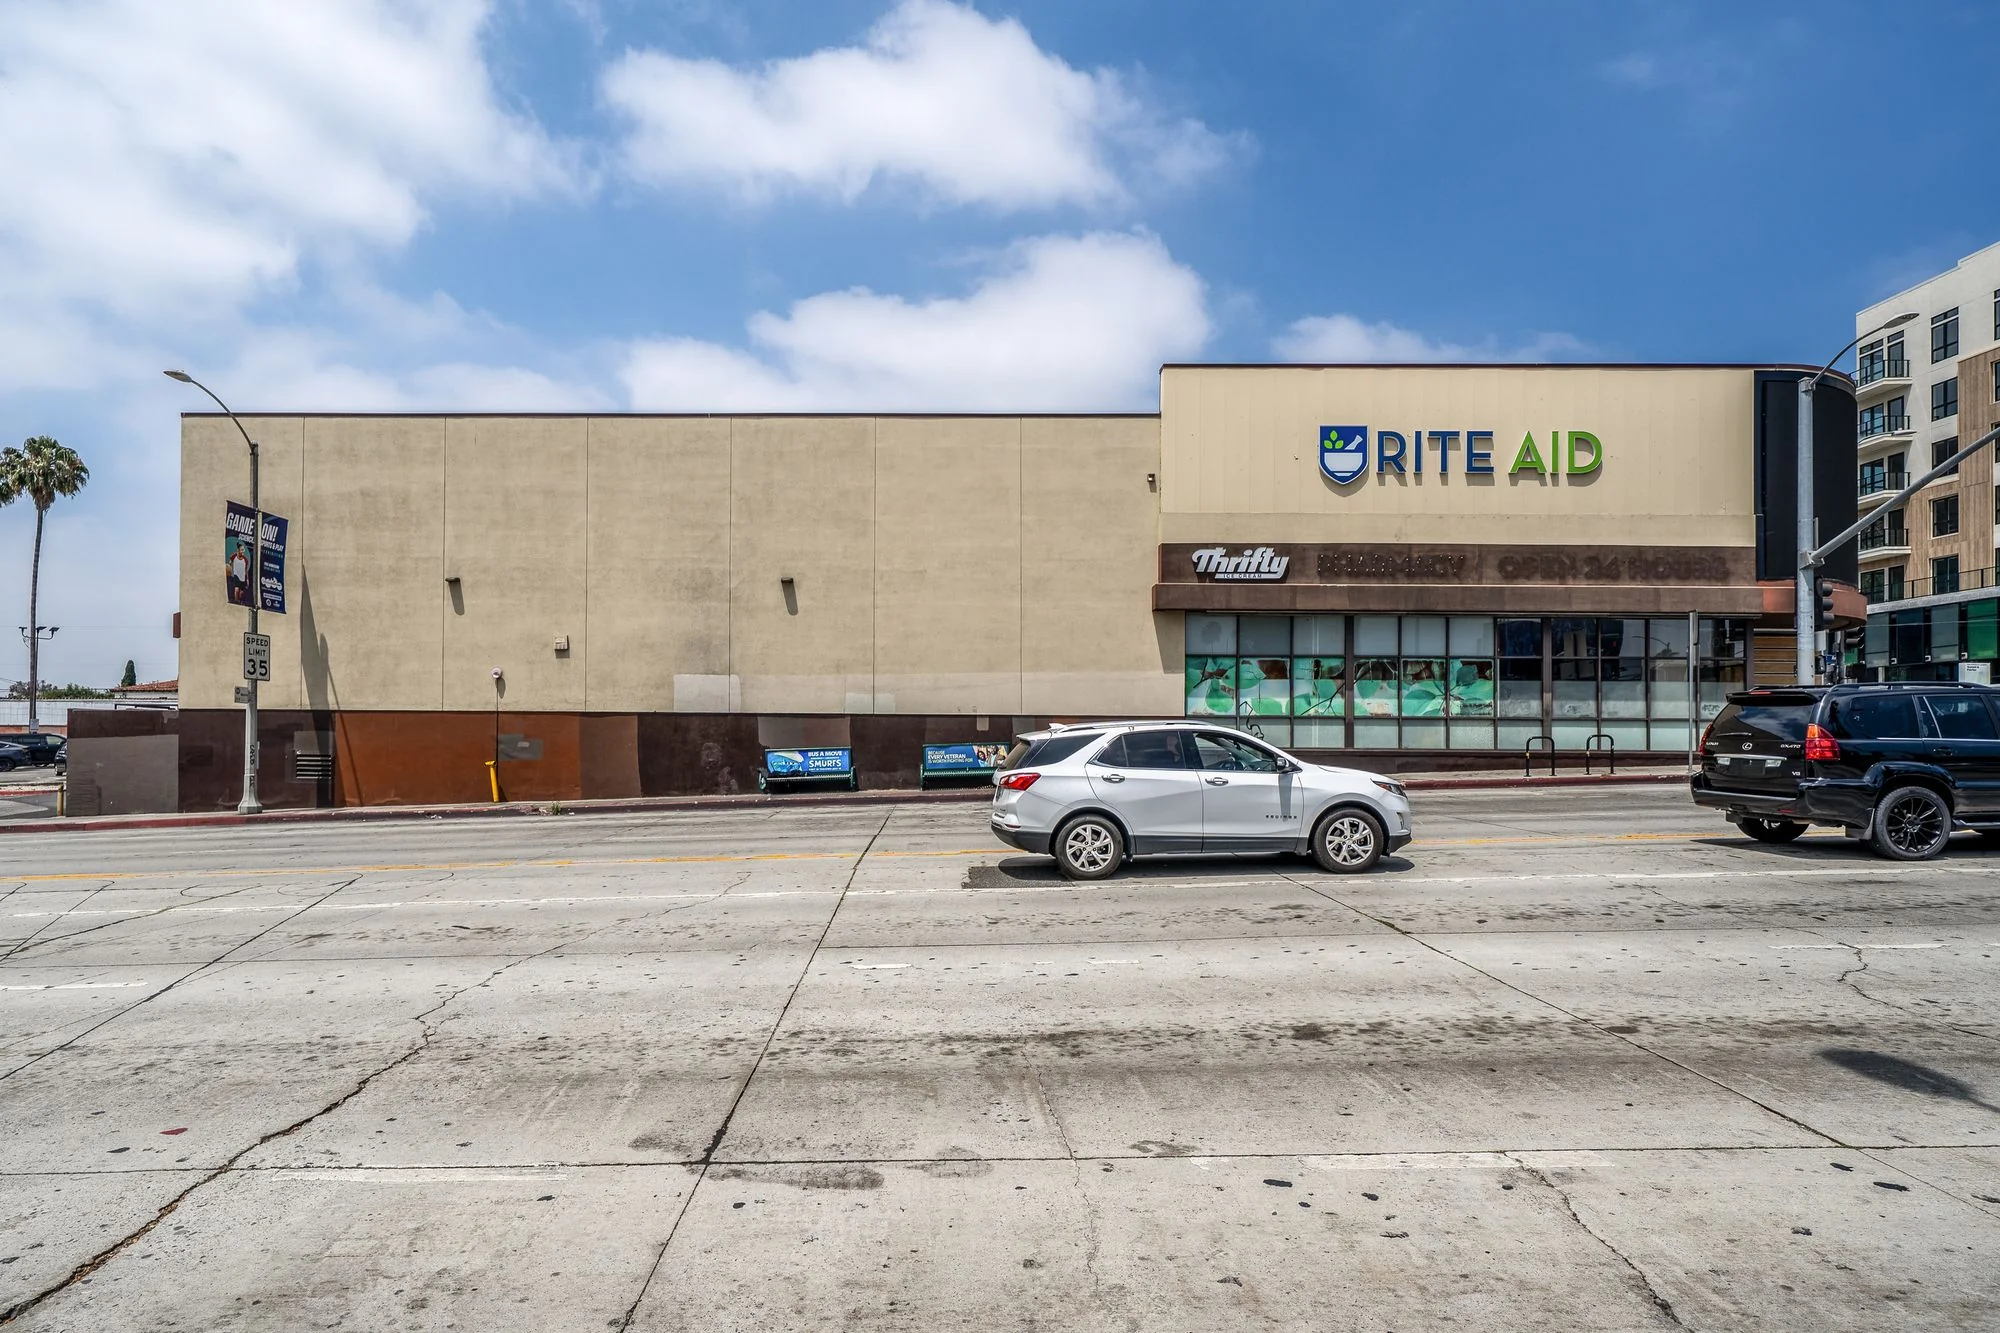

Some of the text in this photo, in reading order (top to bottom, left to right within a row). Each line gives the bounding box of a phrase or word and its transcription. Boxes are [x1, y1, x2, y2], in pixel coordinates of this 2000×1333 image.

[1375, 430, 1603, 474] RITE AID
[226, 512, 255, 535] GAME
[262, 523, 278, 542] ON!
[1192, 547, 1290, 579] Thrifty
[246, 637, 268, 647] SPEED
[248, 647, 266, 657] LIMIT
[247, 658, 267, 676] 35
[808, 759, 842, 768] SMURFS
